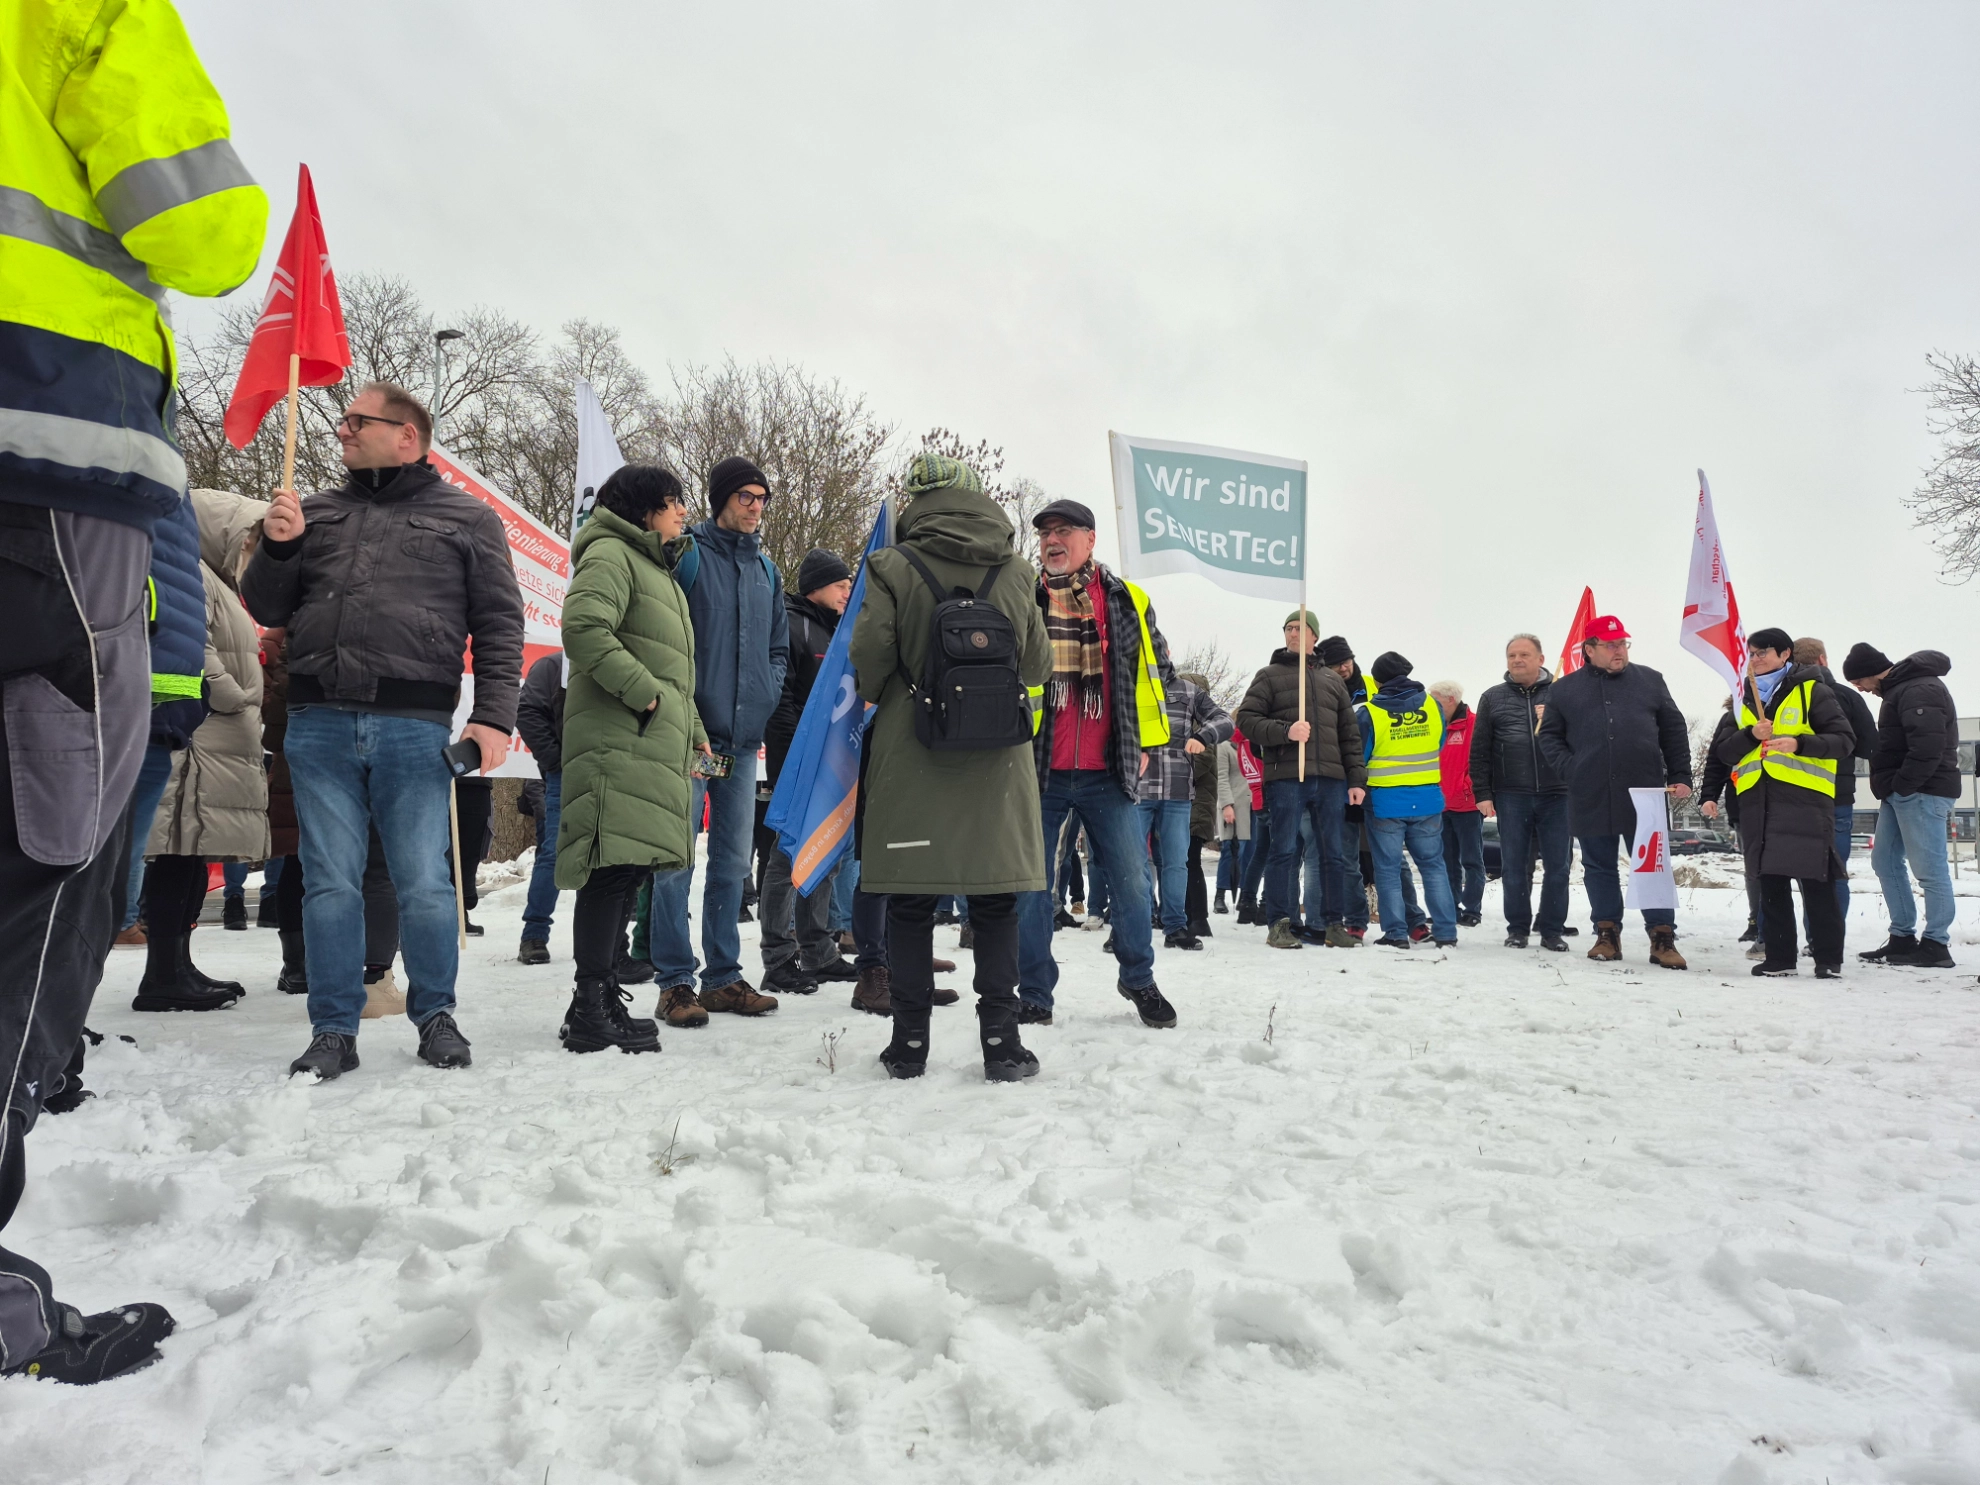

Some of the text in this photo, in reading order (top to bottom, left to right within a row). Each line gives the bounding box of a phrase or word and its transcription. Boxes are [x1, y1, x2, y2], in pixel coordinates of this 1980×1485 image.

[441, 470, 564, 572] Mrientierung
[1144, 462, 1291, 512] Wir sind
